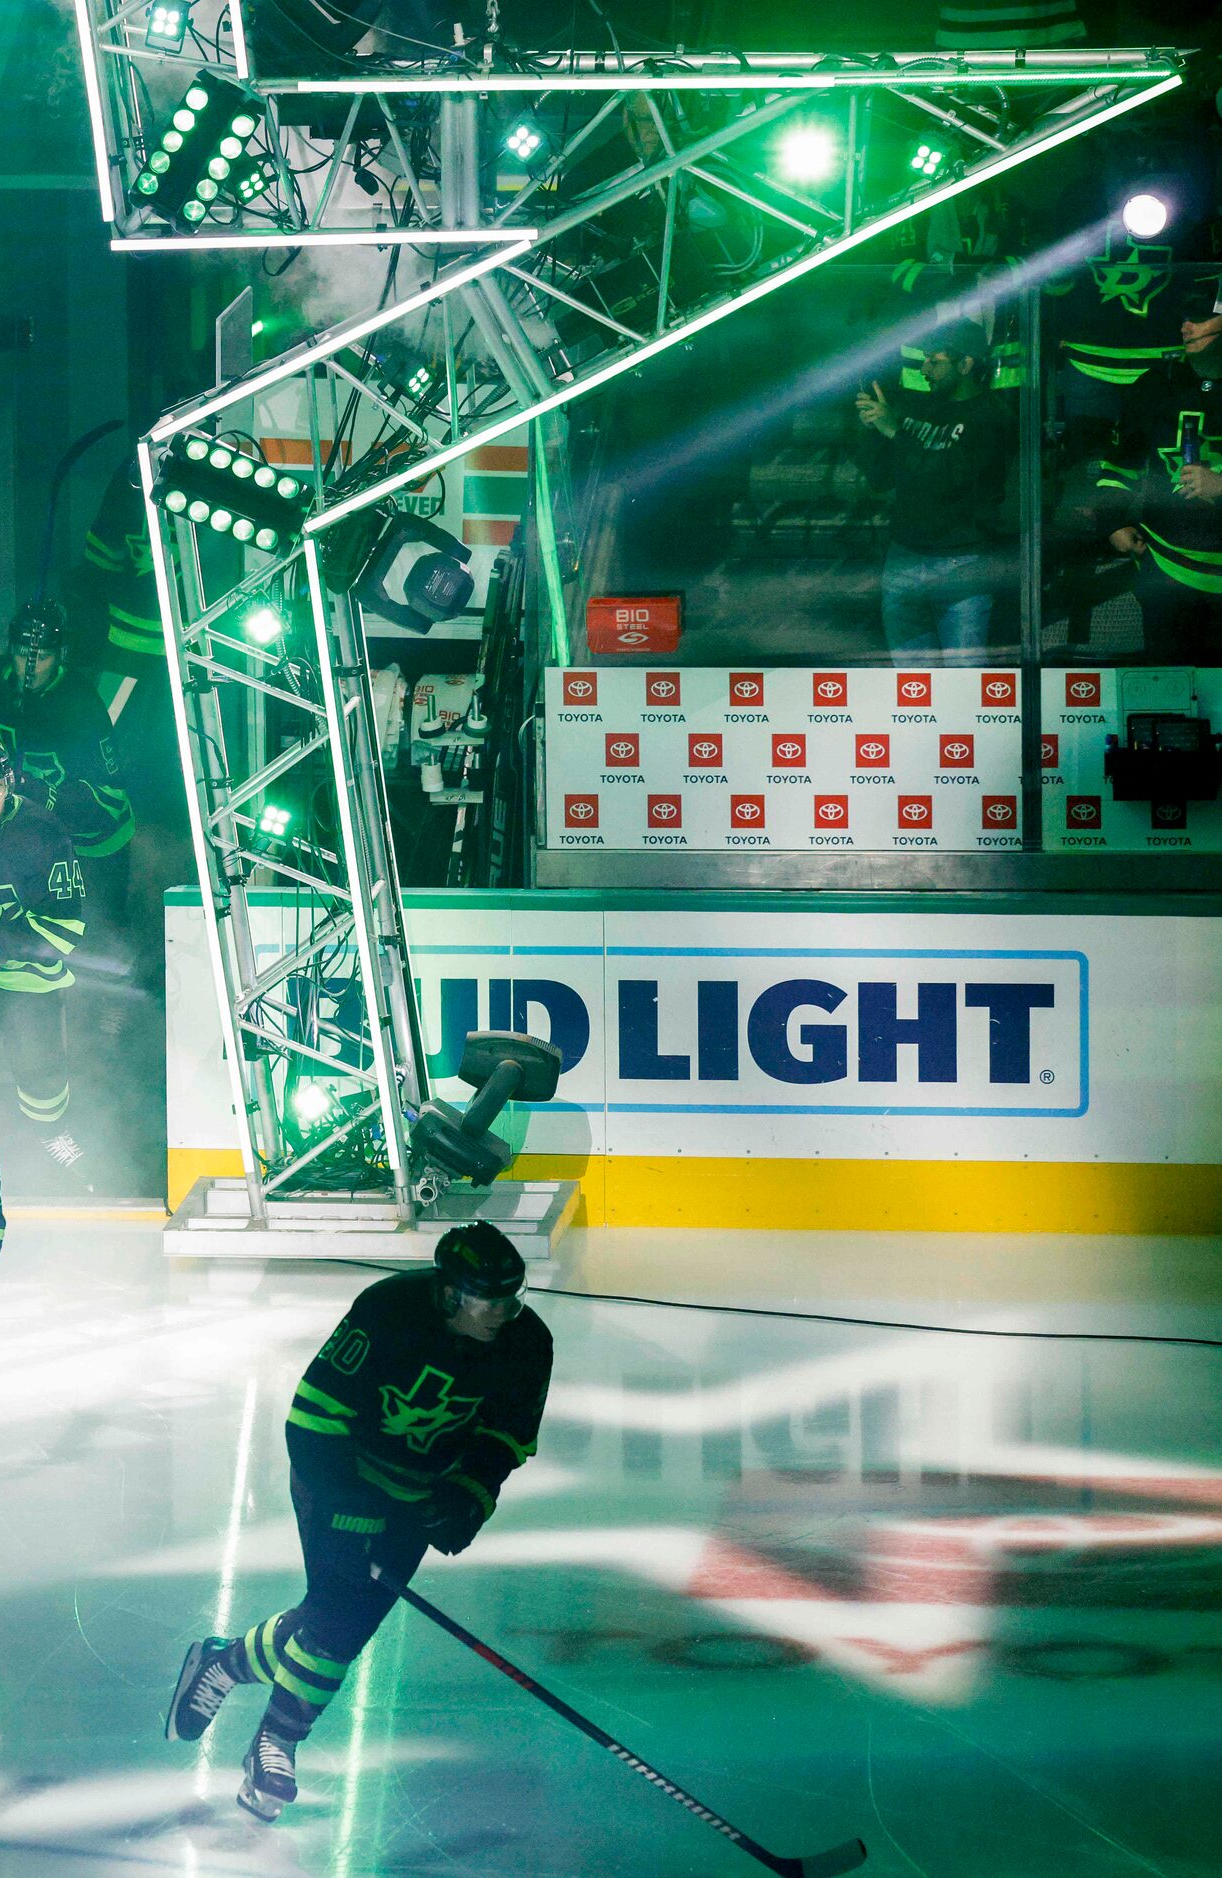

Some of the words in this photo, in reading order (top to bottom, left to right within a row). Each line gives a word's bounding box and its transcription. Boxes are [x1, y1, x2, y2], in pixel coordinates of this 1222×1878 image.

[616, 609, 649, 622] BIO
[557, 713, 603, 723] TOYOTA
[640, 713, 686, 723] TOYOTA
[723, 713, 770, 724] TOYOTA
[807, 714, 853, 724] TOYOTA
[891, 714, 938, 724] TOYOTA
[975, 714, 1022, 724] TOYOTA
[1059, 714, 1107, 724] TOYOTA
[599, 774, 645, 784] TOYOTA
[682, 774, 729, 784] TOYOTA
[765, 775, 812, 785] TOYOTA
[849, 775, 896, 785] TOYOTA
[933, 775, 980, 785] TOYOTA
[559, 835, 605, 845] TOYOTA
[642, 835, 688, 845] TOYOTA
[725, 835, 771, 846] TOYOTA
[808, 836, 855, 846] TOYOTA
[892, 836, 938, 846] TOYOTA
[976, 836, 1022, 847] TOYOTA
[1060, 836, 1107, 846] TOYOTA
[1145, 836, 1192, 846] TOYOTA
[47, 859, 86, 900] 44
